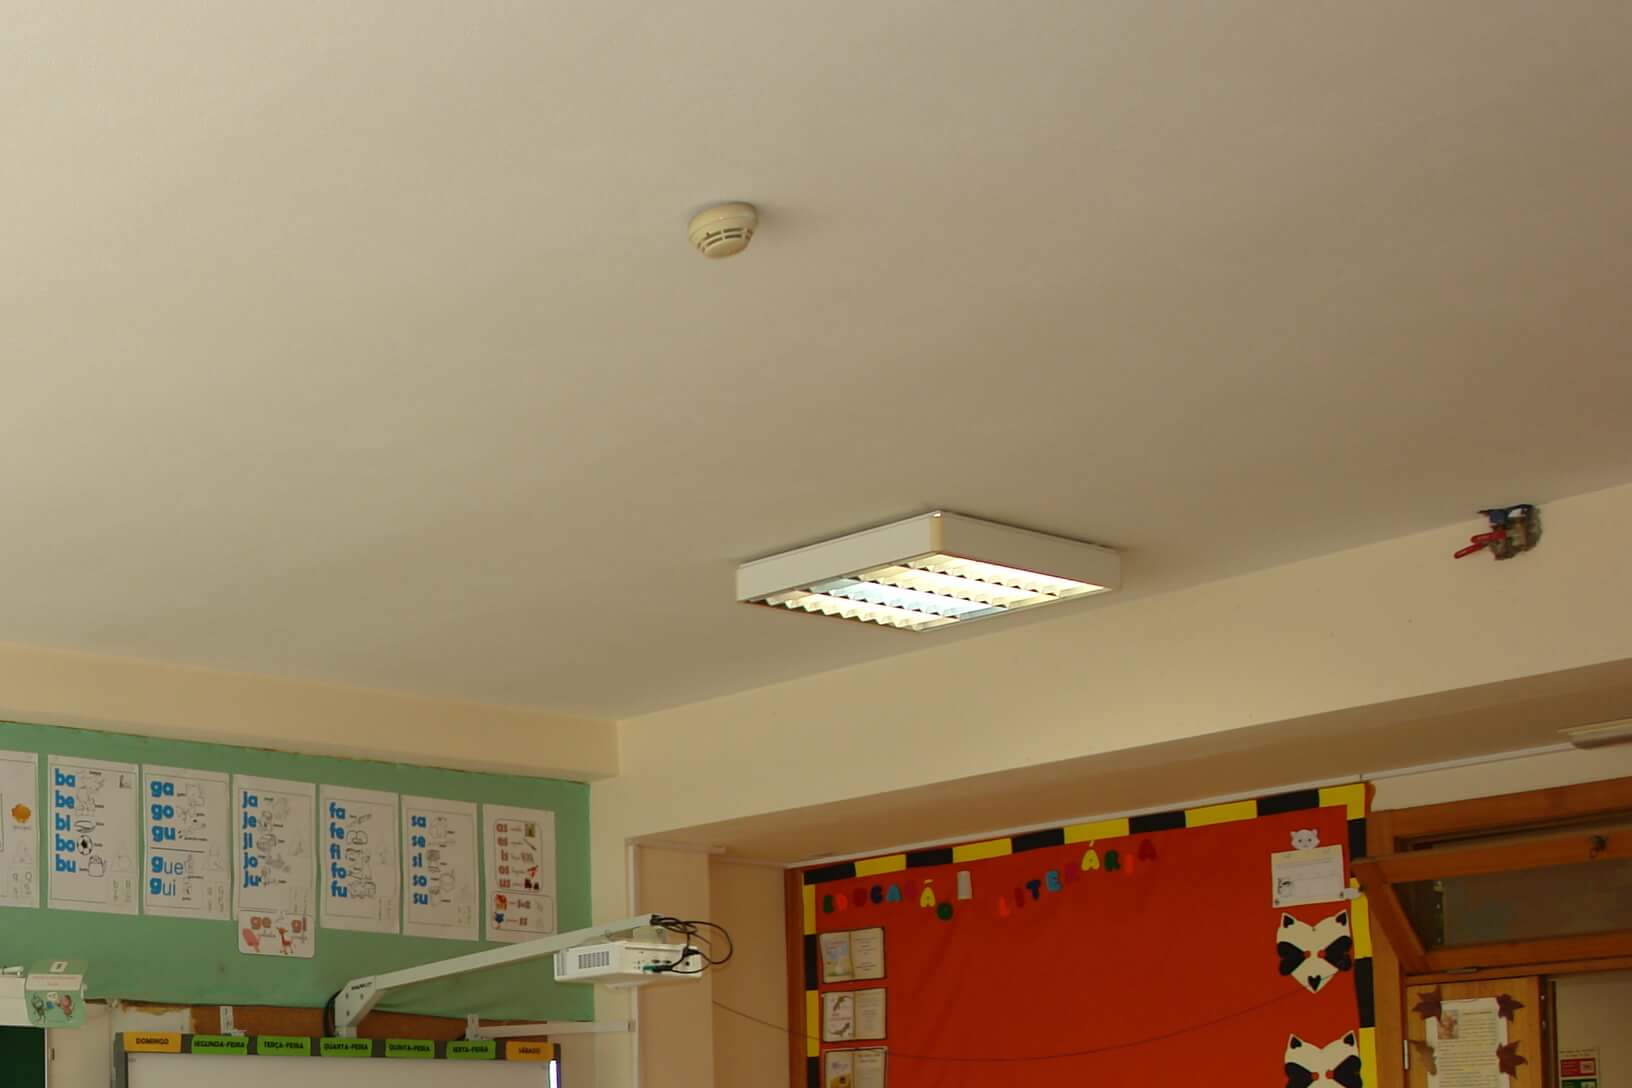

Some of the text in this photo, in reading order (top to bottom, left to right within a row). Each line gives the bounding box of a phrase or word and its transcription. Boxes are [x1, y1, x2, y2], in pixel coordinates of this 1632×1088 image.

[55, 768, 76, 788] ba
[150, 781, 174, 797] ga
[55, 791, 75, 808] be
[242, 792, 258, 808] ja
[151, 804, 174, 820] go
[329, 802, 346, 820] fa
[55, 814, 71, 831] bi
[242, 814, 256, 829] je
[411, 815, 426, 828] sa
[151, 825, 175, 842] gu
[329, 823, 345, 840] fe
[55, 834, 75, 851] bo
[412, 835, 426, 848] se
[329, 844, 341, 860] fi
[55, 854, 76, 873] bu
[243, 853, 258, 869] jo
[412, 853, 422, 868] si
[331, 862, 346, 879] fo
[243, 871, 259, 888] ju
[413, 874, 427, 887] so
[331, 882, 347, 898] fu
[413, 892, 428, 905] su
